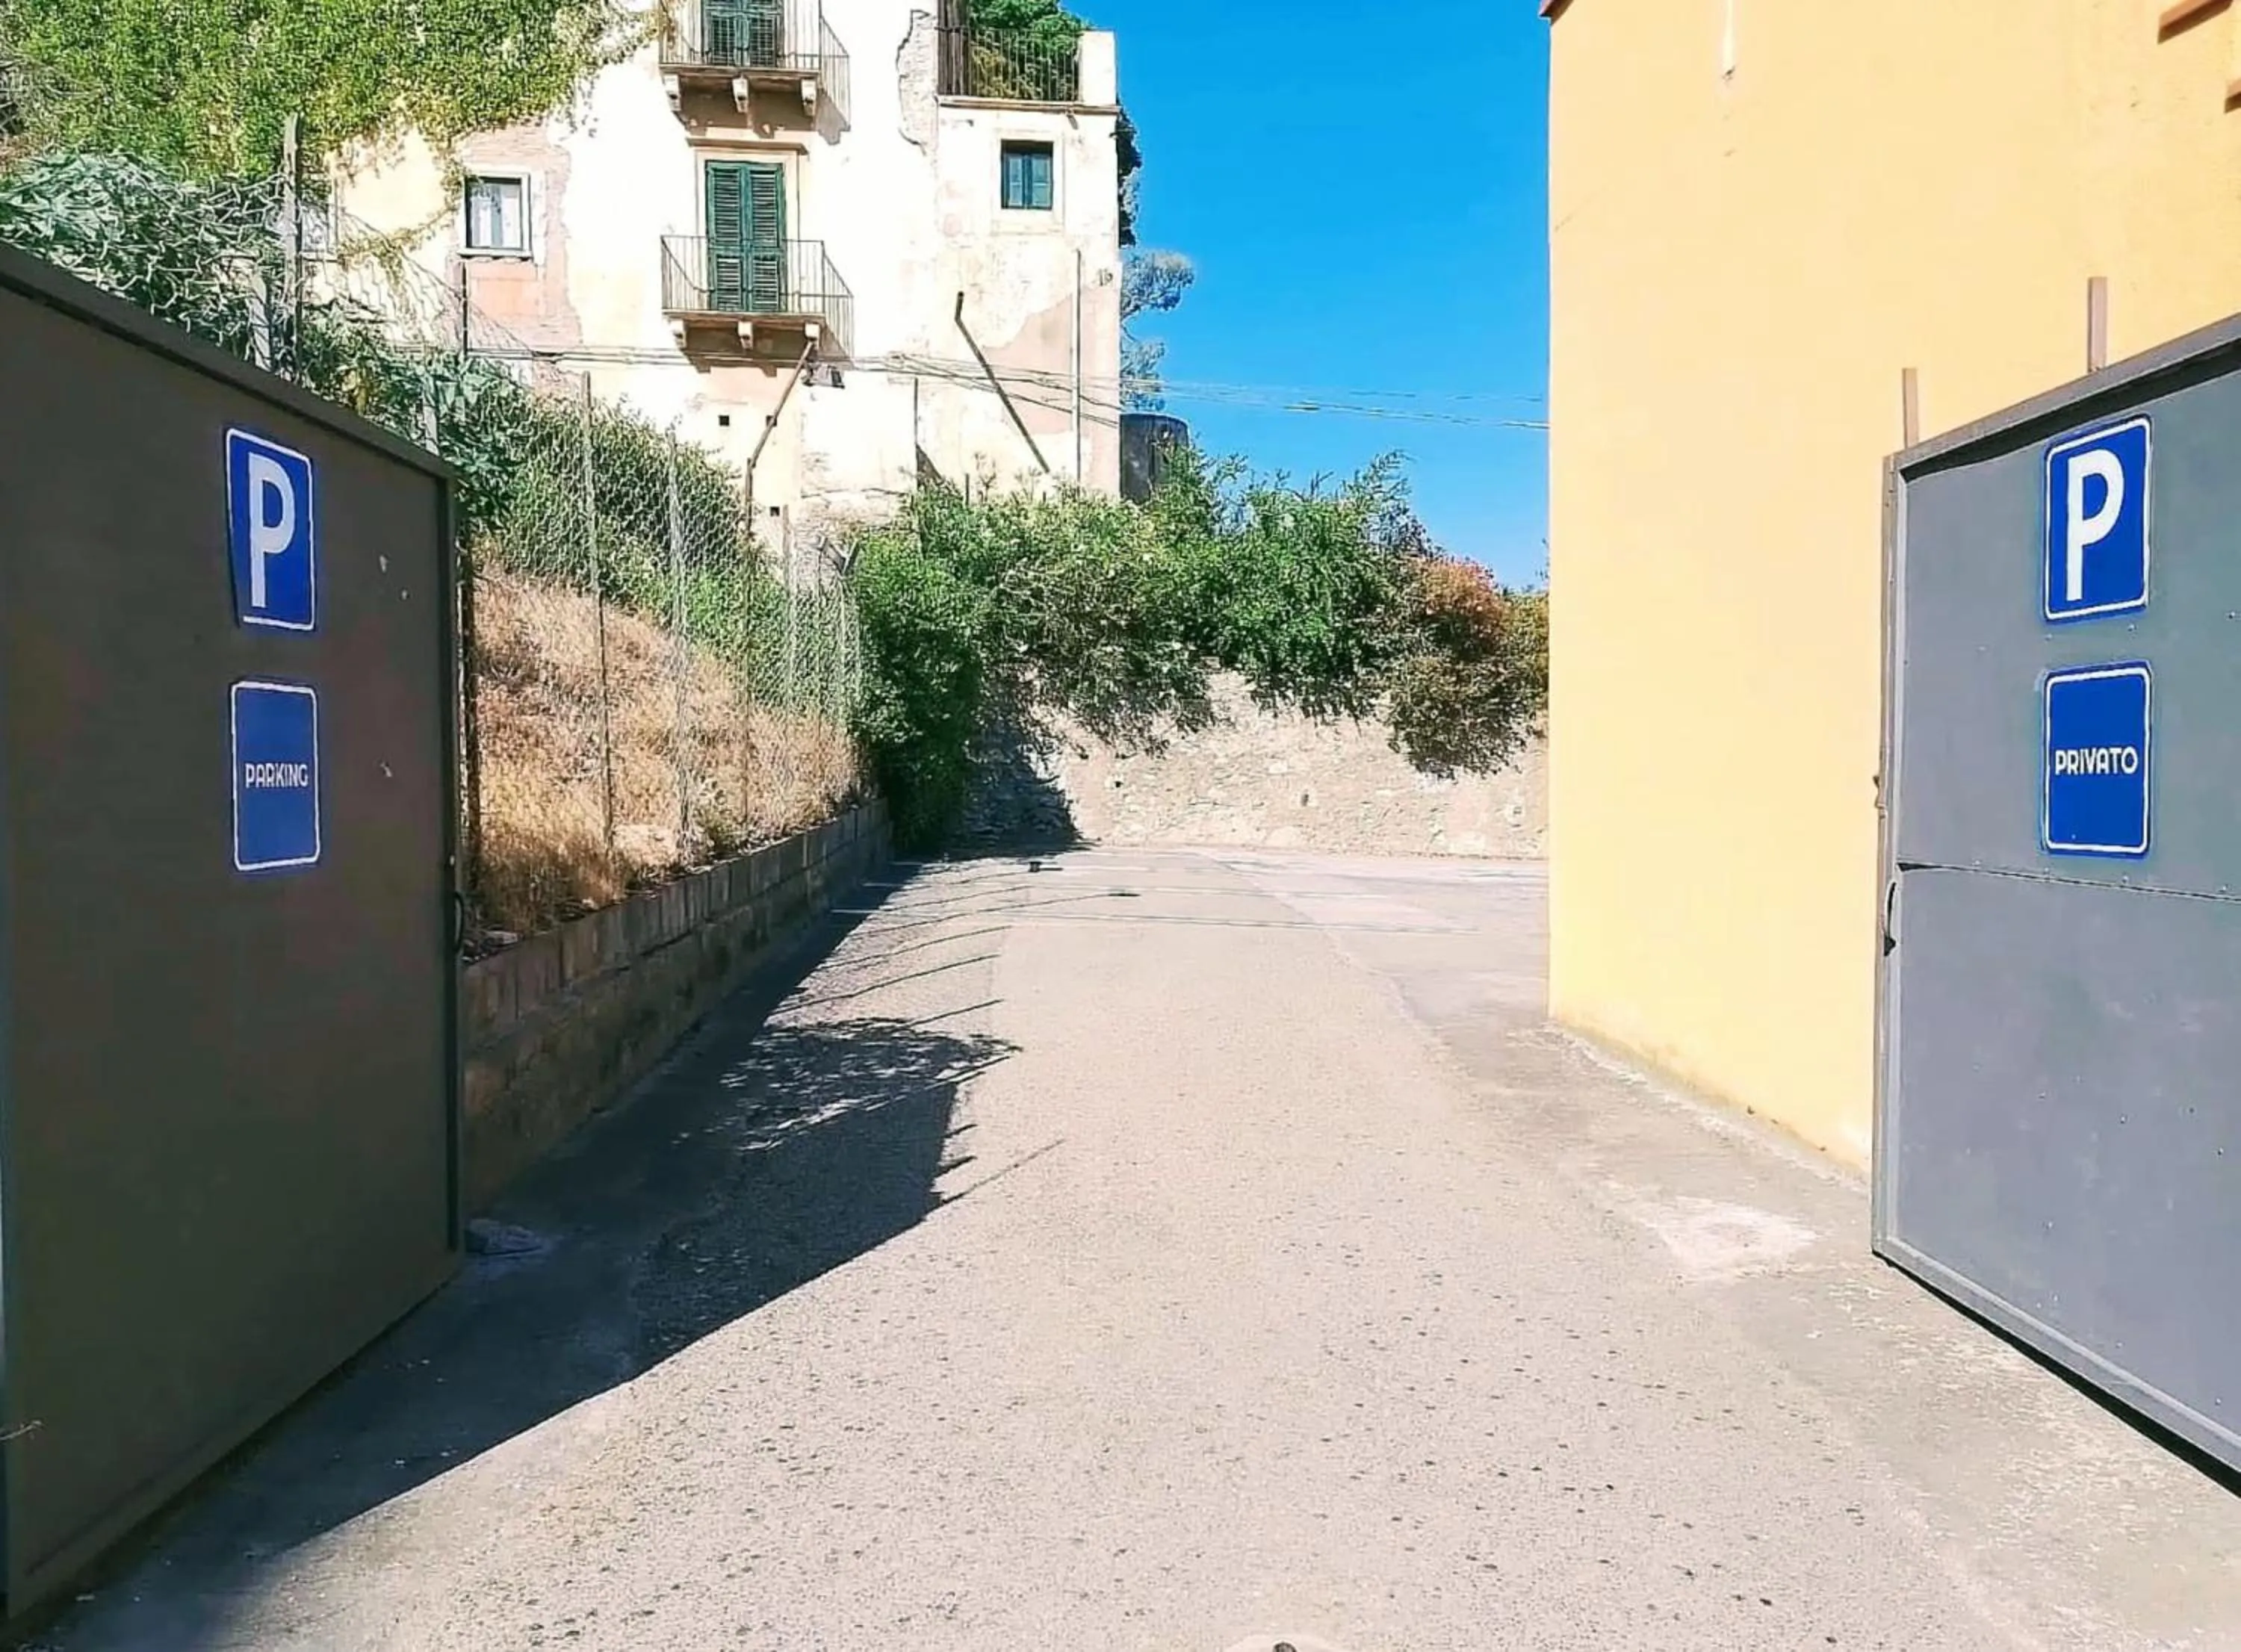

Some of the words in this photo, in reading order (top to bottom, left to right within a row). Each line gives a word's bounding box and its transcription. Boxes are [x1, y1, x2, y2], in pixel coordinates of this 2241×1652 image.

[248, 452, 295, 608] P
[2066, 448, 2125, 602] P
[245, 763, 309, 789] PARKING
[2055, 746, 2138, 775] PRIVATO
